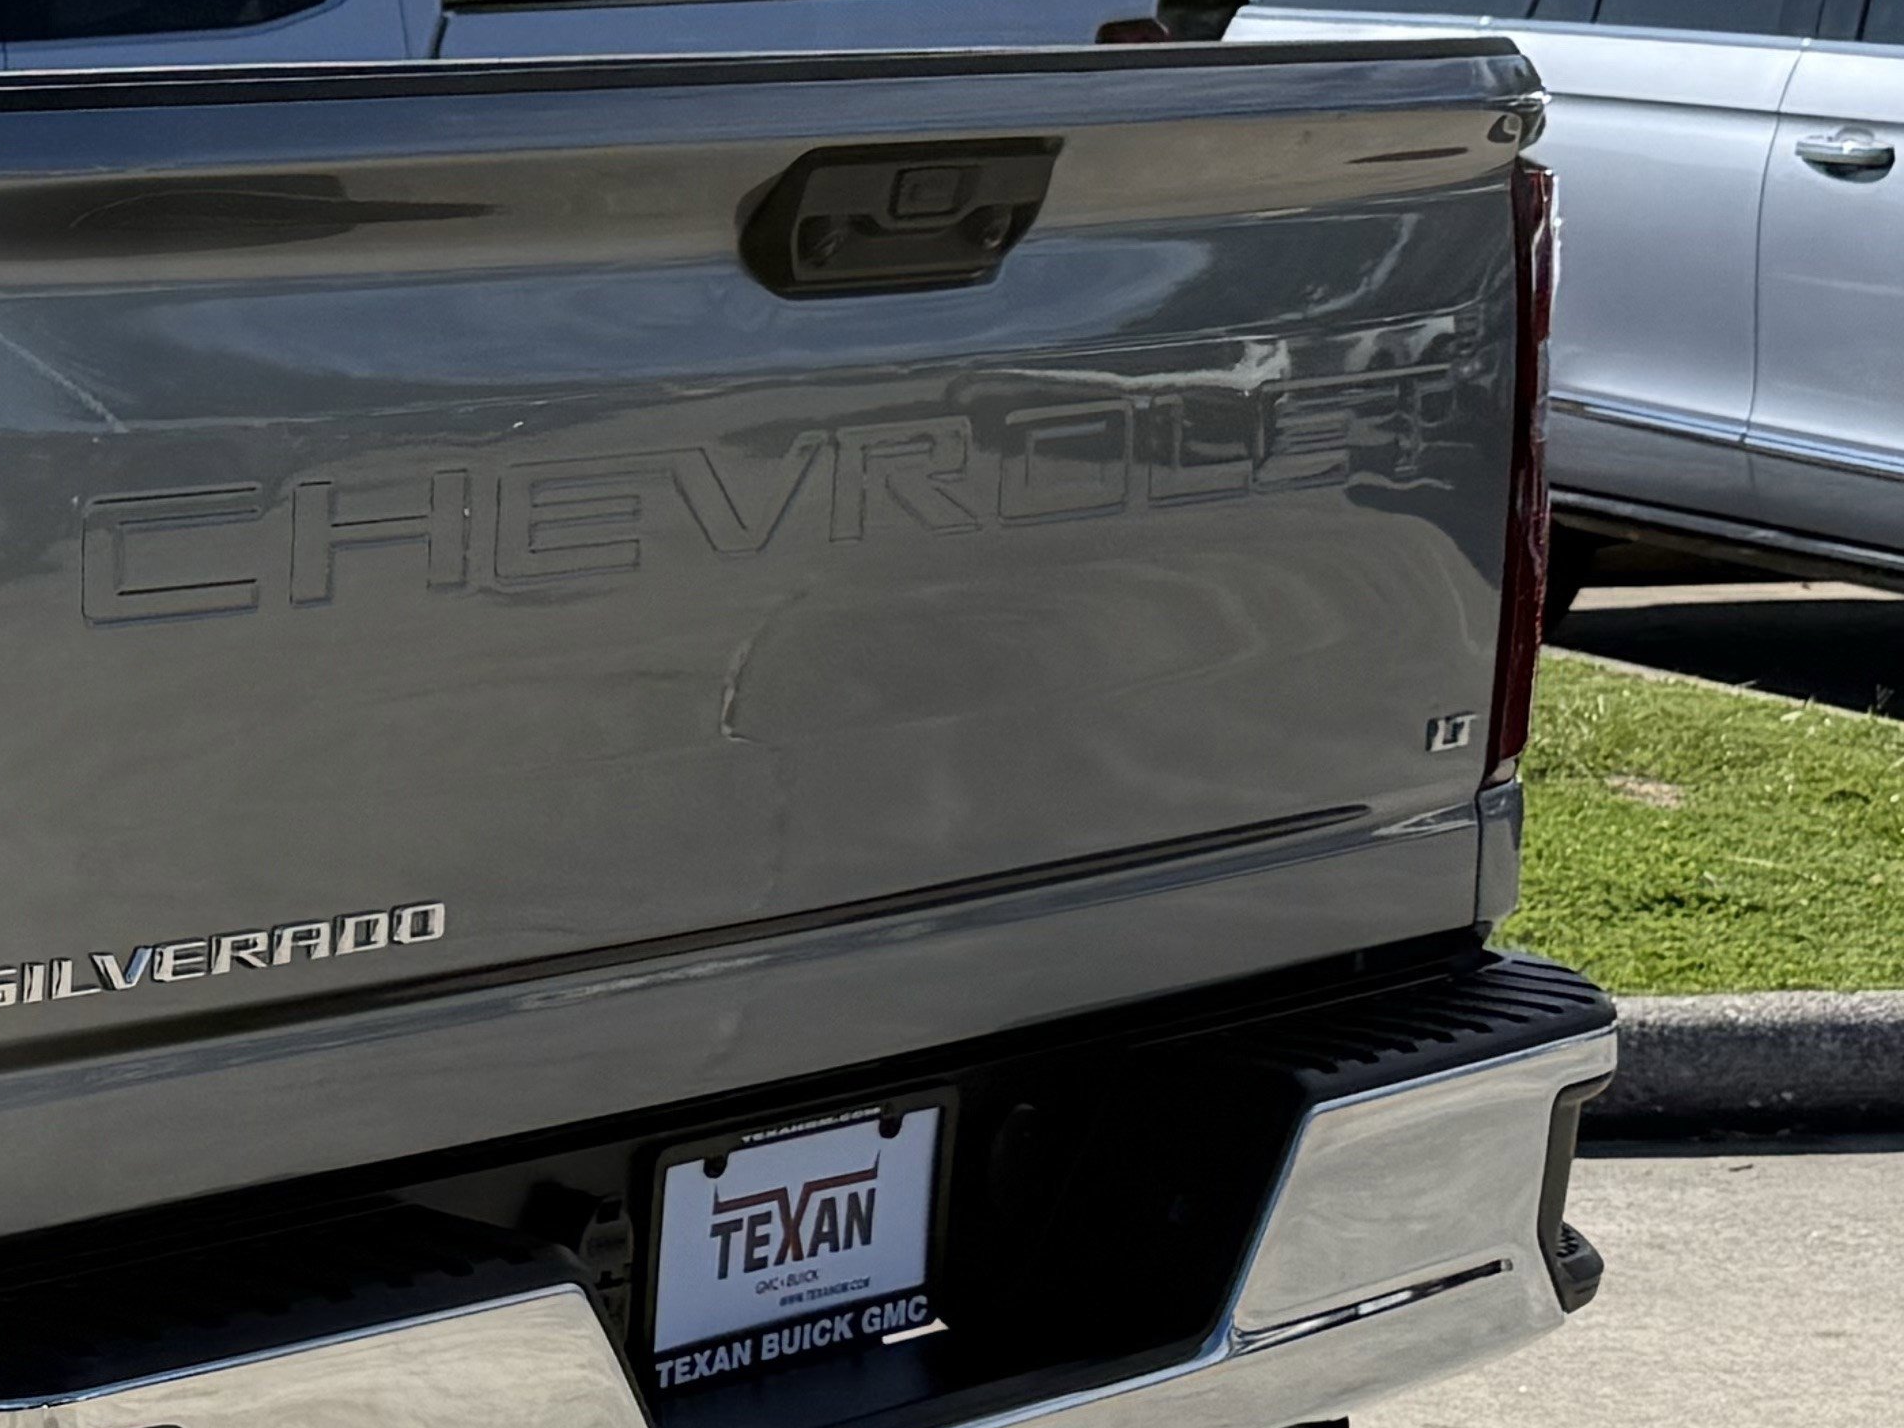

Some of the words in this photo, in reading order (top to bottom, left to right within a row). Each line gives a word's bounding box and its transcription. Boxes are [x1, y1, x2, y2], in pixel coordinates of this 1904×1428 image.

[1427, 712, 1478, 752] LT
[709, 1162, 880, 1281] TEXAN
[654, 1338, 752, 1389] TEXAN
[760, 1311, 854, 1362] BUICK
[860, 1294, 929, 1336] GMC
